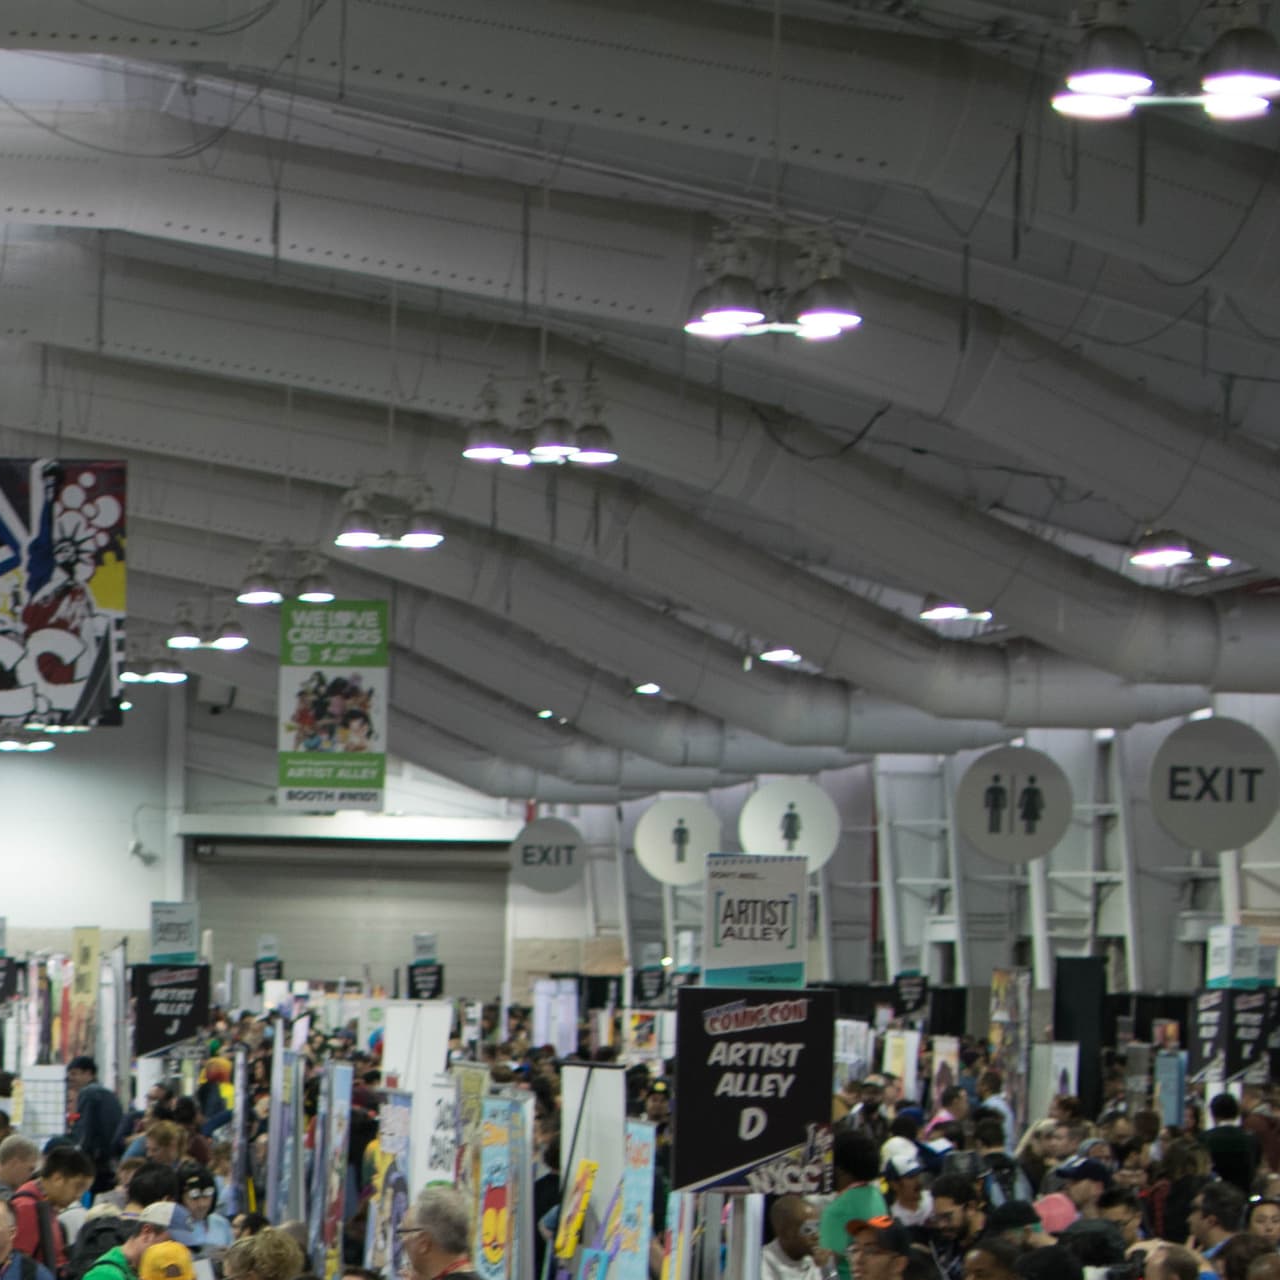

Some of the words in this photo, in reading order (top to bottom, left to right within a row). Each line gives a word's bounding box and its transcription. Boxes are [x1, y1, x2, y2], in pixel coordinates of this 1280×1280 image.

[290, 611, 324, 628] WE
[287, 628, 382, 645] CREATORS
[288, 767, 332, 779] ARTIST
[336, 767, 378, 779] ALLEY
[1169, 766, 1265, 804] EXIT
[287, 790, 335, 801] BOOTH
[522, 846, 577, 867] EXIT
[720, 898, 791, 925] ARTIST
[721, 926, 790, 941] ALLEY
[151, 988, 199, 1001] ARTIST
[153, 1002, 194, 1016] ALLEY
[709, 1007, 763, 1031] COMIC
[768, 1001, 805, 1024] CON
[164, 1018, 181, 1036] J
[706, 1041, 807, 1068] ARTIST
[713, 1072, 796, 1098] ALLEY
[737, 1106, 768, 1142] D
